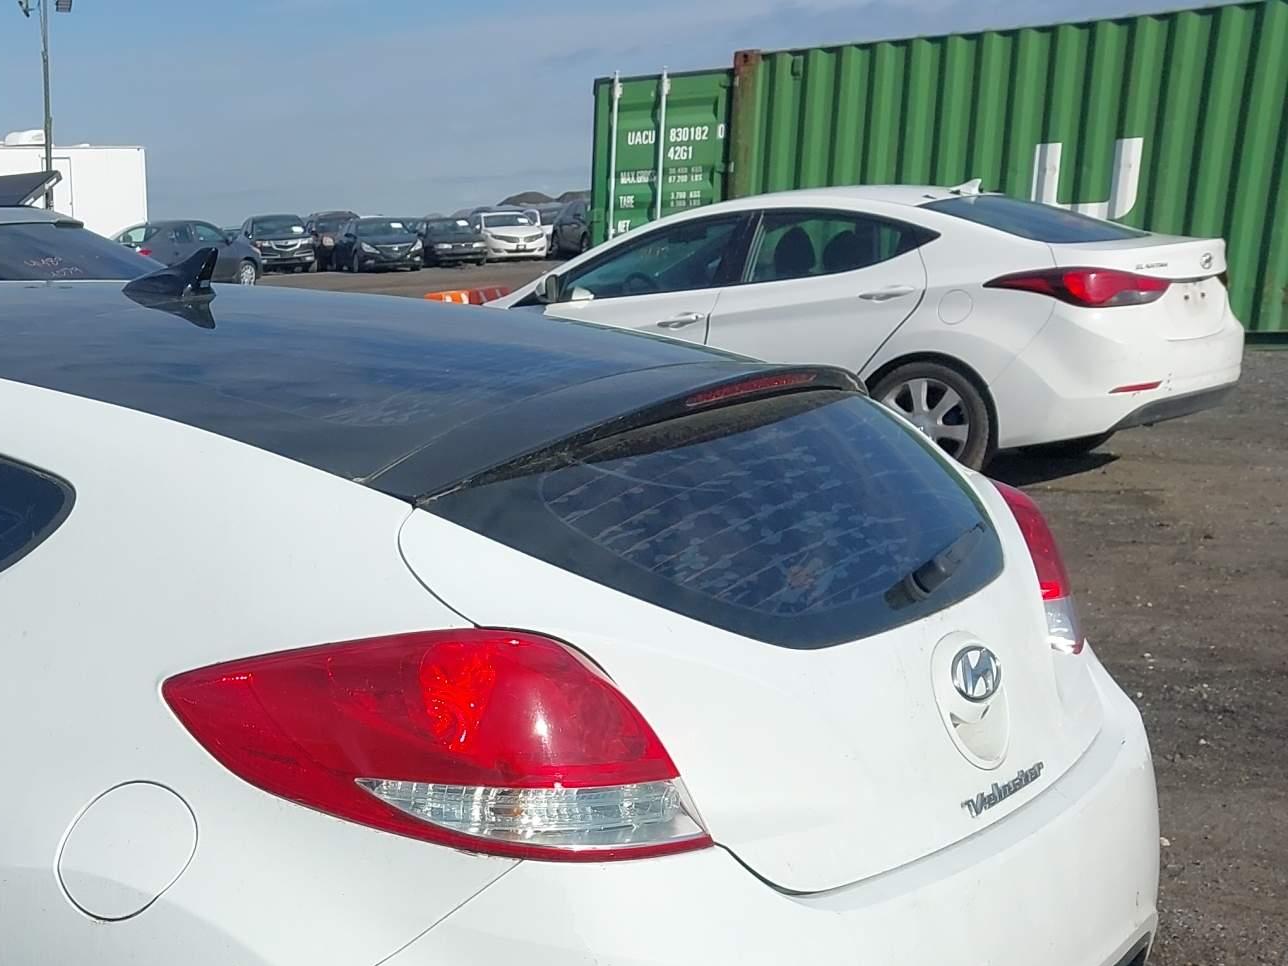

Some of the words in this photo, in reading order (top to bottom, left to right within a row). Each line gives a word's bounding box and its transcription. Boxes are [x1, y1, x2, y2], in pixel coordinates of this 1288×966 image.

[627, 130, 656, 145] UACU
[669, 126, 709, 142] 830182
[667, 145, 693, 160] 42G1
[961, 761, 1044, 818] Veloster
